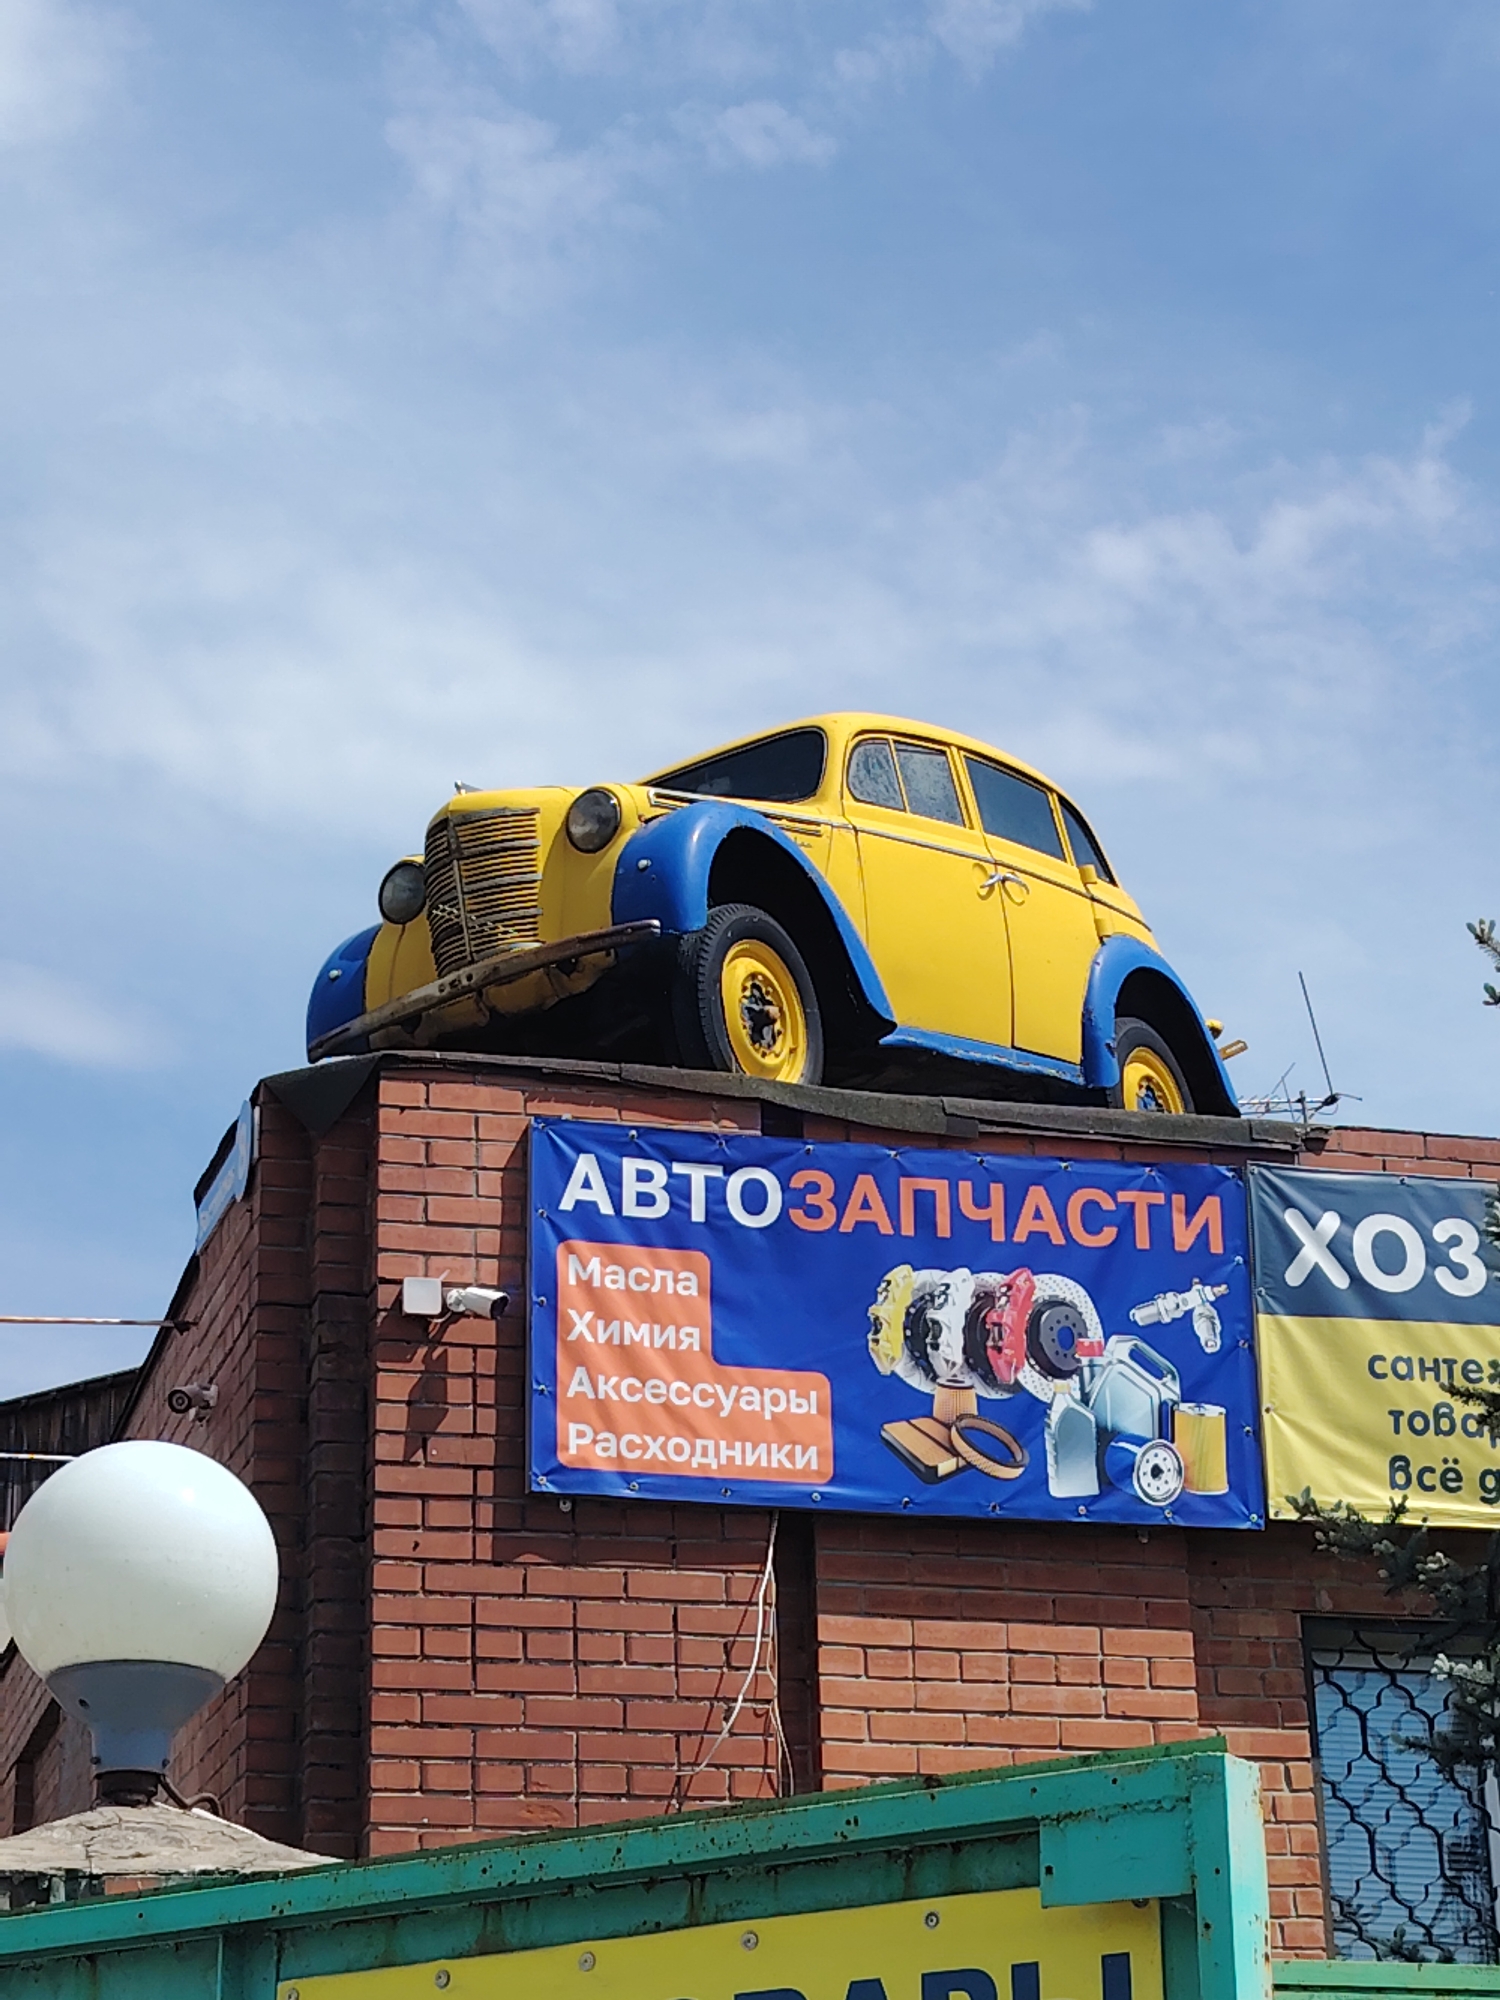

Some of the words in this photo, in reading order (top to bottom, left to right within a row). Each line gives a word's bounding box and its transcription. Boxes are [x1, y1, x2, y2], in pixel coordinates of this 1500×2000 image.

[559, 1153, 1225, 1254] АВТОЗАПЧАСТИ
[567, 1254, 699, 1297] Масла
[566, 1308, 701, 1351] Химия
[566, 1366, 818, 1420] Аксессуары
[567, 1422, 819, 1470] Расходники
[1388, 1402, 1500, 1449] това
[1389, 1455, 1463, 1493] всё
